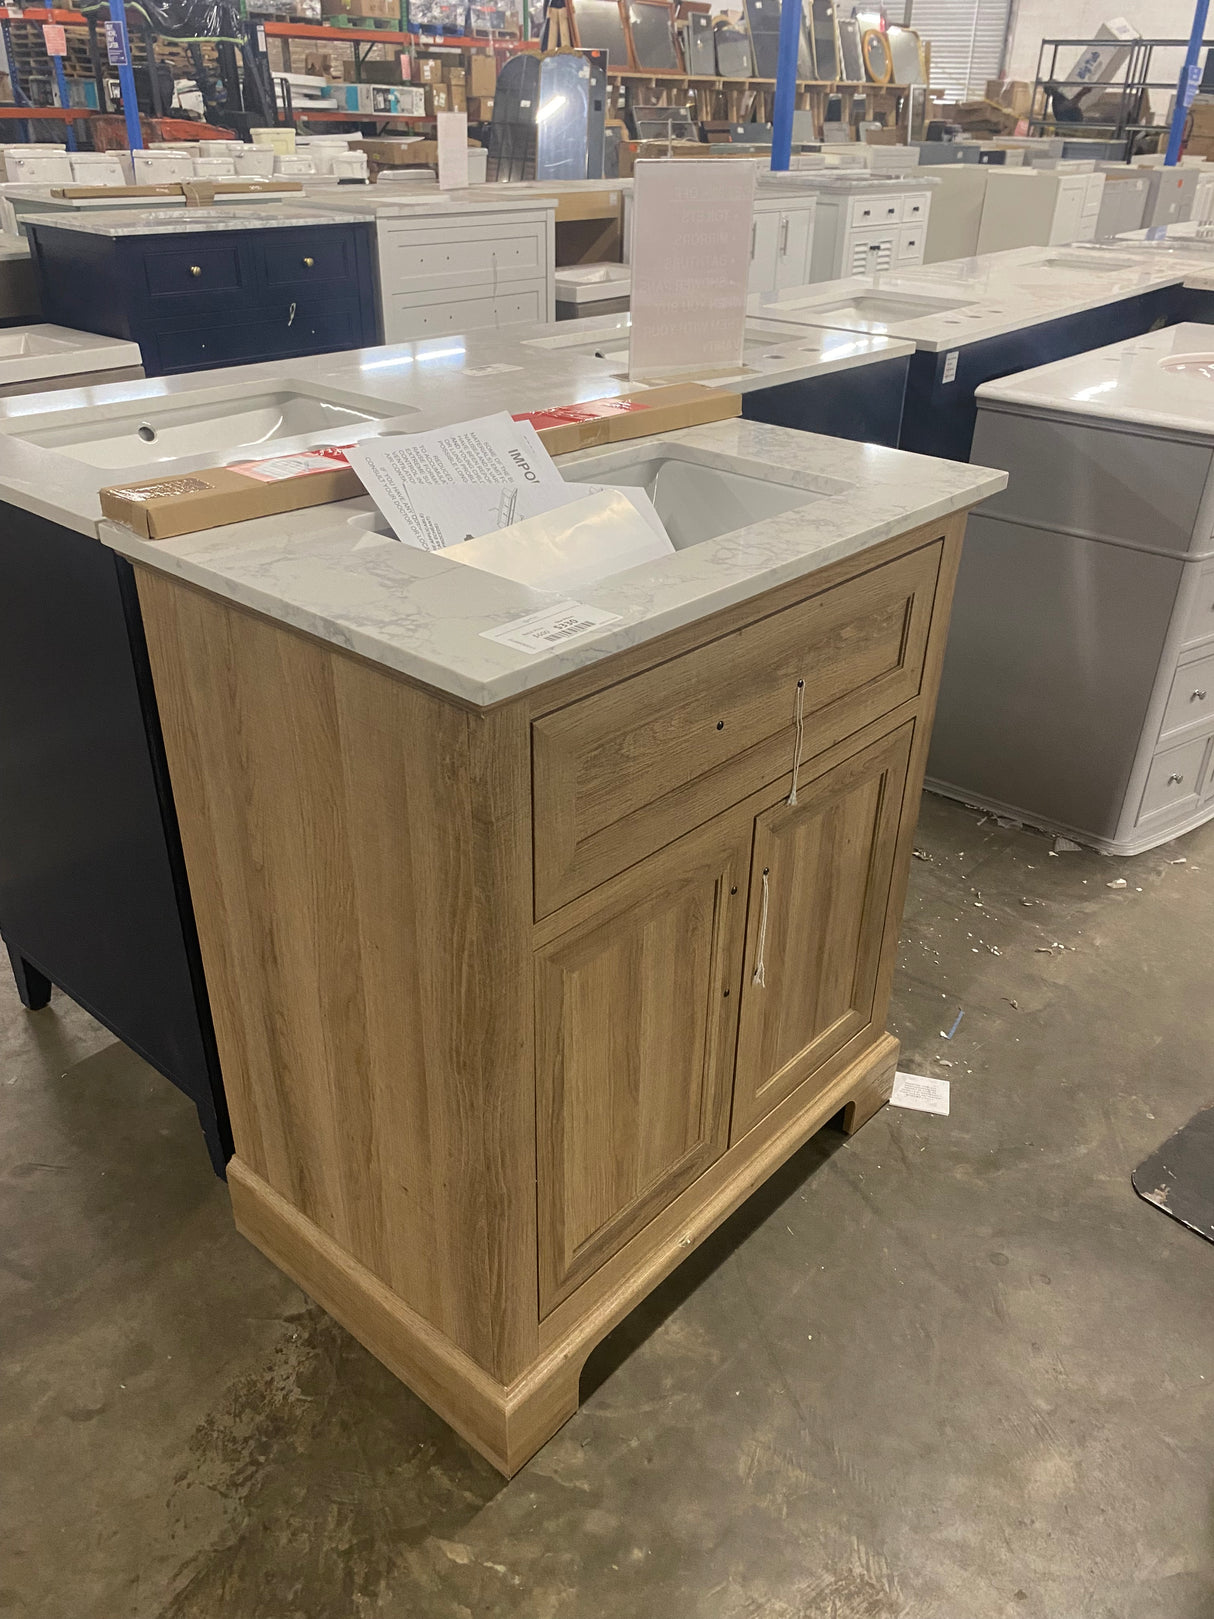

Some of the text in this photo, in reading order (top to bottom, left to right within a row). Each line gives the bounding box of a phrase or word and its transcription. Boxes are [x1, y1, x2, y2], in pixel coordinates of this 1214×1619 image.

[397, 449, 419, 476] CONTROL
[404, 448, 425, 474] EXTREME
[449, 447, 463, 463] LUNG
[450, 437, 461, 449] AND
[457, 449, 474, 469] YOUNG
[432, 455, 454, 481] REDUCED
[365, 456, 385, 483] CONSULT
[383, 483, 396, 500] YOUR
[393, 500, 413, 524] DOCTOR
[383, 473, 395, 486] YOU
[391, 486, 405, 502] HAVE
